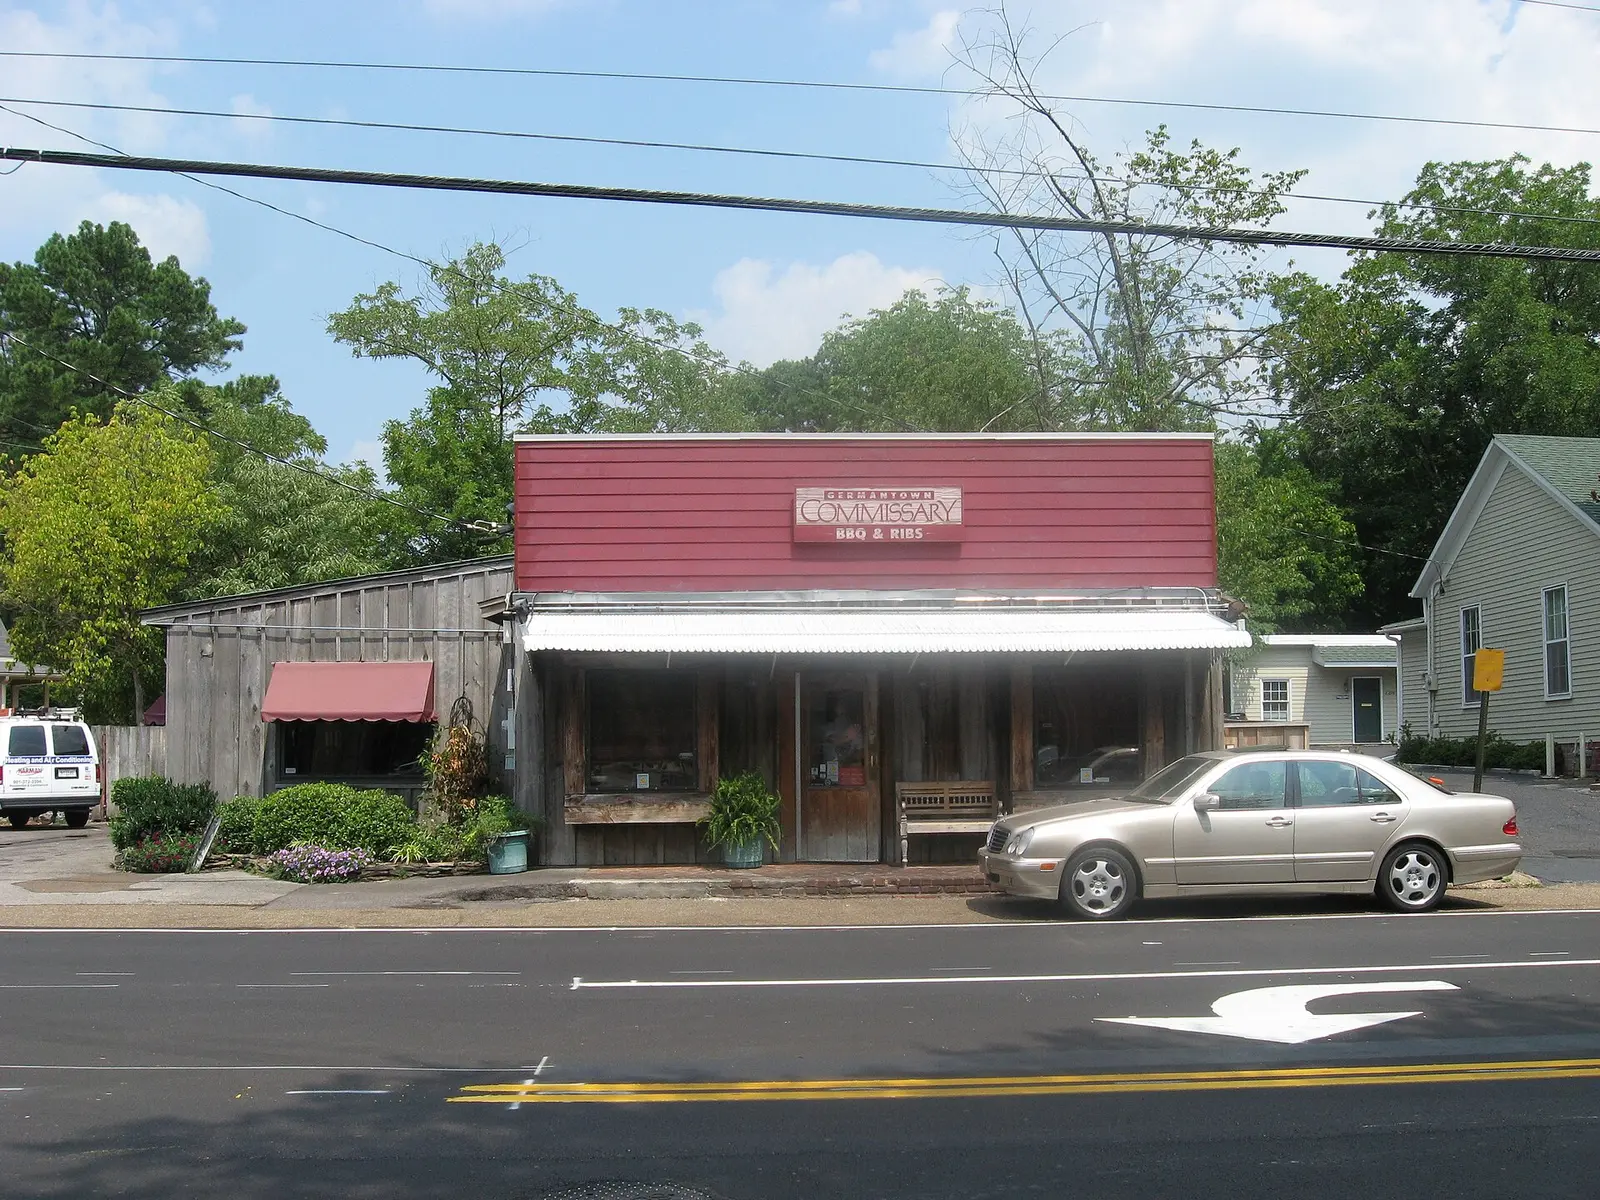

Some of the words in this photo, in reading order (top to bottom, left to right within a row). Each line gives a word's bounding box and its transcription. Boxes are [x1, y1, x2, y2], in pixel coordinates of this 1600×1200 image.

[827, 491, 932, 499] GERMANTOWN
[800, 499, 958, 523] COMMISSARY
[836, 528, 867, 540] BBQ
[872, 528, 884, 540] &
[890, 528, 924, 540] RIBS
[5, 756, 30, 764] Heating
[55, 756, 94, 764] Conditioning
